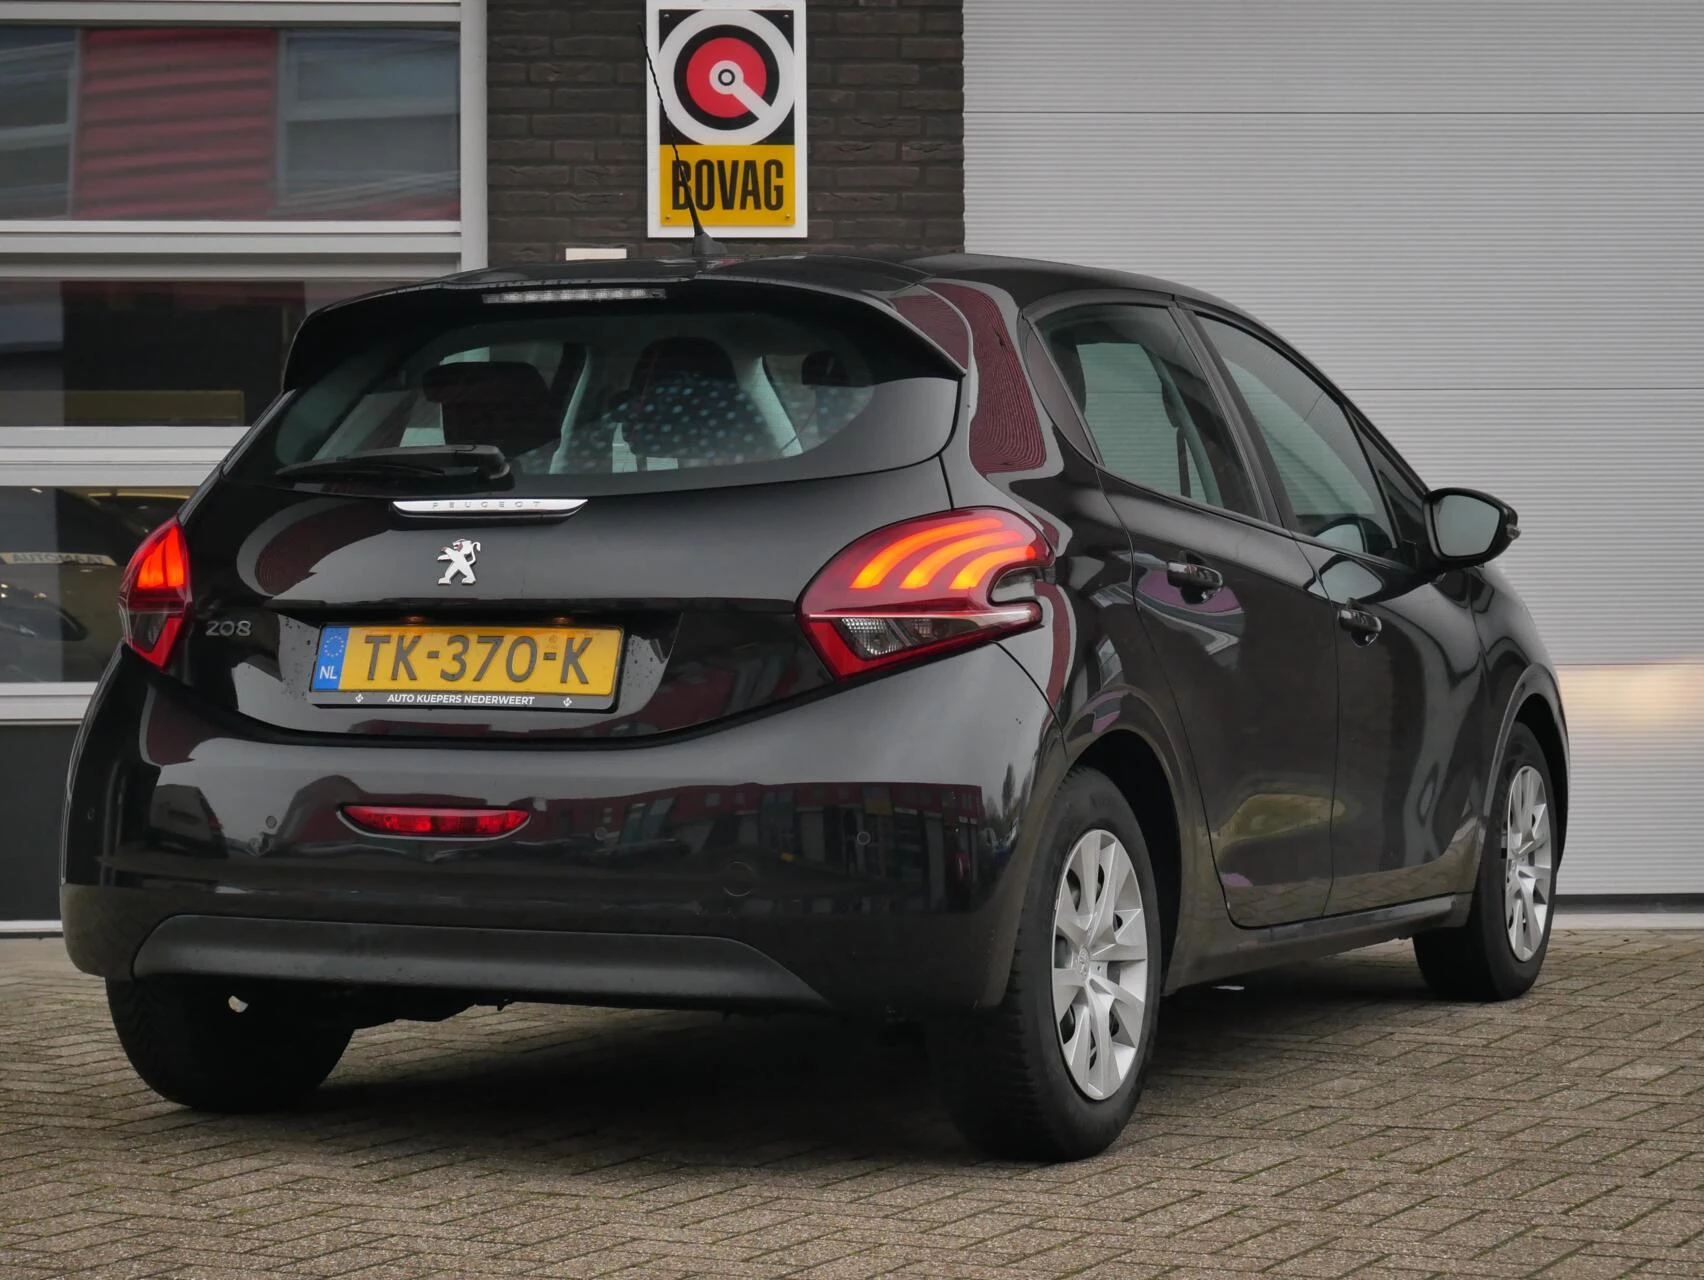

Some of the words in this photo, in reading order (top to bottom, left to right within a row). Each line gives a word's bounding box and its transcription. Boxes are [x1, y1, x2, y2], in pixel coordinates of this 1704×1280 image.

[672, 159, 784, 211] BOVAG
[432, 501, 541, 509] PEUGEOT
[206, 620, 251, 637] 208
[364, 634, 593, 685] TK-370-K
[319, 665, 338, 680] NL
[387, 694, 415, 703] AUTO
[416, 695, 462, 704] KUEPERS
[464, 695, 535, 705] NEDERWEERT
